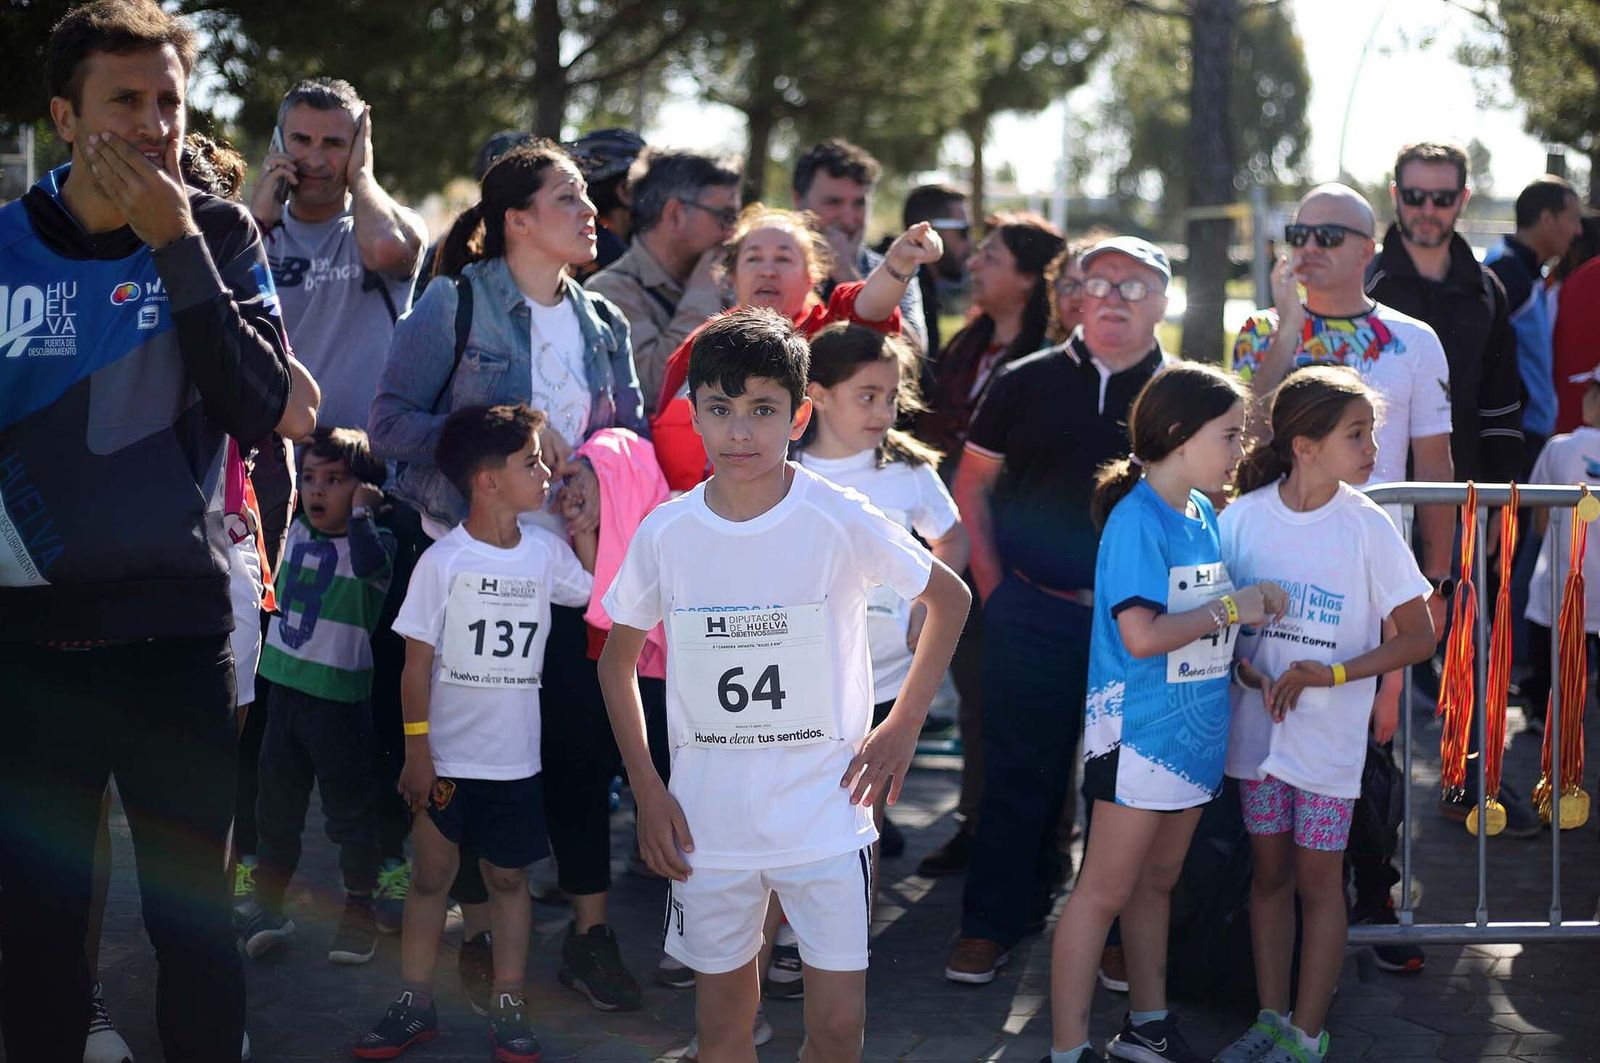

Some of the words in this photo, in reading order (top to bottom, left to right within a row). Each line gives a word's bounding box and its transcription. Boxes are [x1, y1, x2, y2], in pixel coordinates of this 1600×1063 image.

[46, 281, 77, 299] HU
[46, 299, 77, 316] EL
[47, 317, 77, 334] VA
[44, 338, 65, 347] PUERTA
[66, 338, 76, 347] DEL
[28, 347, 77, 356] DESCUBRIMIENTO
[482, 578, 498, 592] H
[1309, 593, 1343, 611] kilos
[707, 616, 727, 633] H
[728, 611, 788, 624] DIPUTACIÓN
[1307, 610, 1315, 621] x
[1320, 610, 1340, 625] km
[729, 624, 743, 632] DE
[747, 620, 788, 631] HUELVA
[730, 630, 767, 638] OBJETIVOS
[468, 619, 538, 658] 137
[450, 670, 480, 682] Huelva
[504, 676, 516, 684] tus
[717, 664, 786, 713] 64
[694, 732, 727, 744] Huelva
[729, 733, 754, 745] eleva
[758, 733, 775, 743] tus
[777, 728, 824, 742] sentidos.
